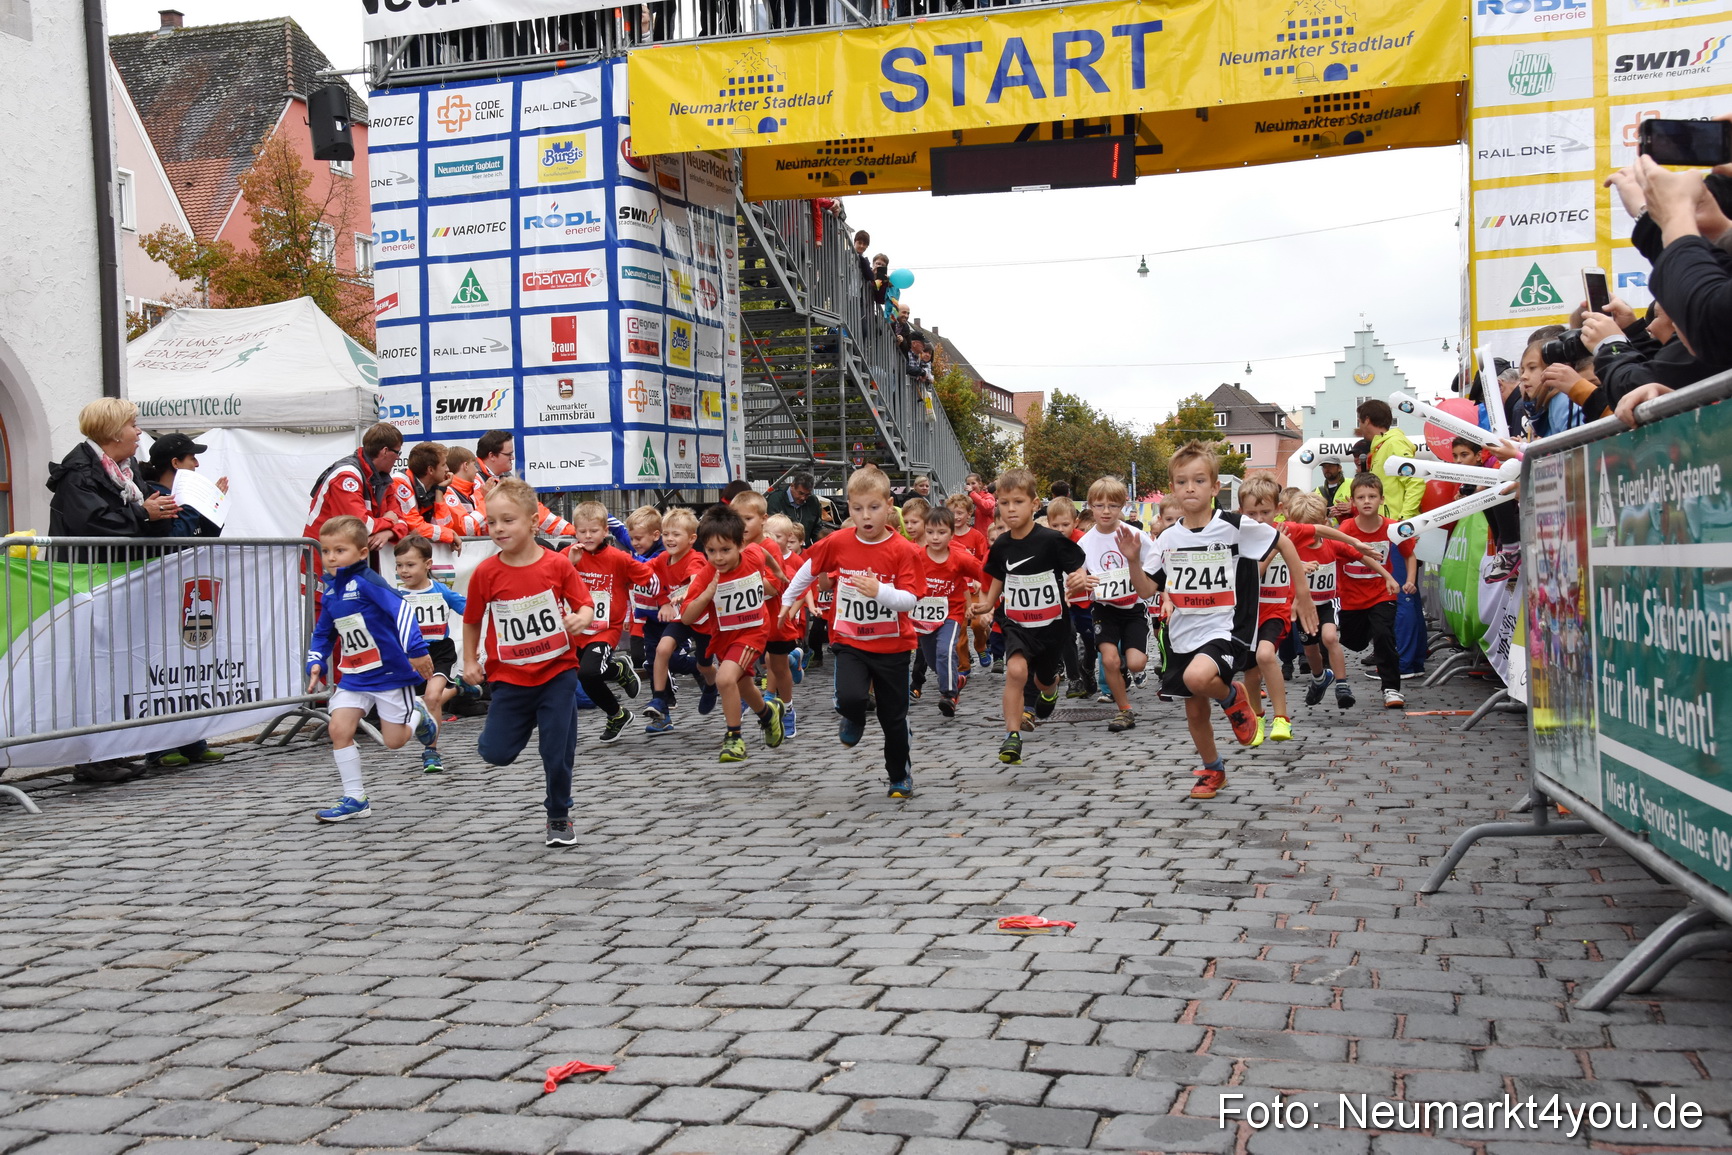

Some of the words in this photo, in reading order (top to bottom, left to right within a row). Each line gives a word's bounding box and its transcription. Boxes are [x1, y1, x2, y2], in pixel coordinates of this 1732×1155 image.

[1533, 6, 1587, 23] energie
[1219, 40, 1325, 67] Neumarkter
[1329, 30, 1414, 56] Stadtlauf
[880, 20, 1163, 113] START
[1510, 50, 1550, 75] RUND
[1614, 48, 1691, 73] swn
[1614, 70, 1663, 82] stadtwerke
[1665, 66, 1711, 77] neumarkt
[1509, 72, 1556, 96] SCHAU
[475, 100, 500, 112] CODE
[524, 99, 578, 114] RAIL.ONE
[669, 96, 760, 117] Neumarkter
[763, 89, 833, 110] Stadtlauf
[475, 108, 504, 121] CLINIC
[1254, 113, 1347, 135] Neumarkter
[1348, 102, 1420, 126] Stadtlauf
[542, 147, 583, 167] Burgis
[776, 154, 852, 172] Neumarkter
[854, 150, 918, 168] Stadtlauf
[1478, 145, 1556, 160] RAIL.ONE
[437, 162, 474, 175] Neumarkter
[474, 159, 501, 171] Tagblatt
[619, 205, 649, 223] swn
[1510, 208, 1589, 227] VARIOTEC
[452, 221, 507, 237] VARIOTEC
[565, 220, 601, 236] energie
[382, 240, 416, 253] energie
[526, 270, 582, 287] charivari
[434, 345, 487, 357] RAIL.ONE
[552, 341, 575, 353] Braun
[436, 395, 484, 415] swn
[546, 402, 588, 411] Neumarkter
[435, 414, 467, 422] stadtwerke
[468, 412, 497, 420] neumarkt
[539, 407, 596, 422] Lammsbräu
[529, 459, 586, 471] RAIL.ONE
[1618, 462, 1721, 511] Event-Leit-Systeme
[1192, 553, 1226, 563] BOCK
[1172, 565, 1228, 591] 7244
[1307, 573, 1334, 590] 180
[512, 595, 548, 612] BOCK
[720, 585, 763, 613] 7206
[1008, 584, 1056, 608] 7079
[1184, 596, 1216, 606] Patrick
[415, 604, 446, 624] 011
[737, 612, 759, 623] Timur
[841, 598, 893, 622] 7094
[1022, 613, 1043, 621] Vitus
[1600, 584, 1639, 643] Mehr
[498, 608, 556, 642] 7046
[857, 625, 875, 634] Max
[512, 640, 551, 657] Leopold
[146, 658, 245, 688] Neumarkter
[1602, 659, 1624, 719] für
[1627, 667, 1649, 729] Ihr
[1654, 676, 1717, 756] Event!
[1606, 769, 1628, 810] Miet
[1629, 782, 1639, 817] &
[1639, 787, 1677, 842] Service
[1678, 808, 1710, 861] Line:
